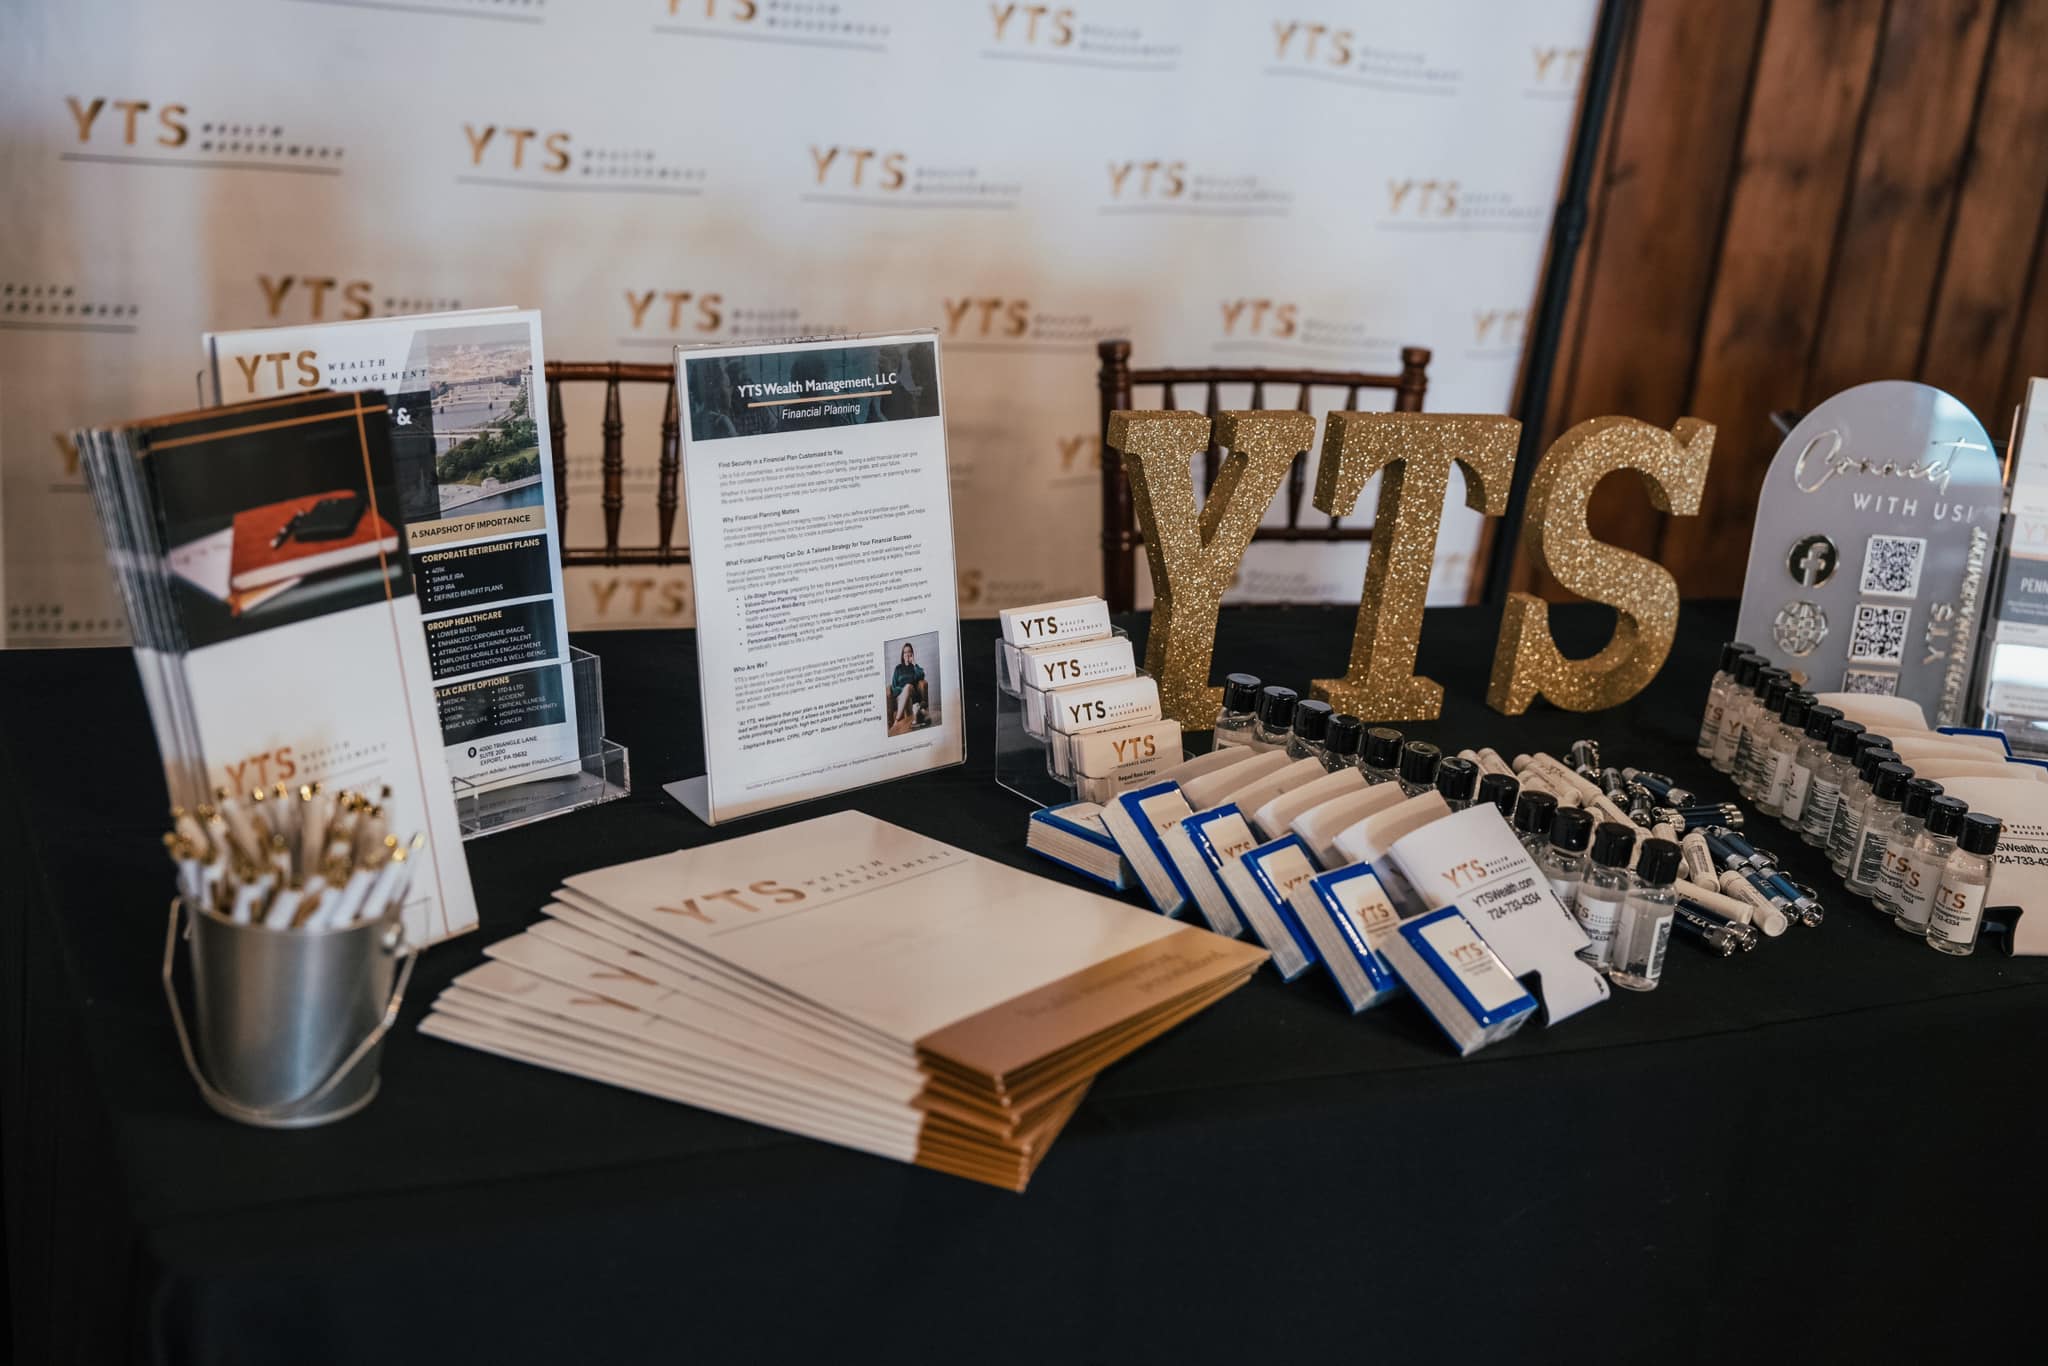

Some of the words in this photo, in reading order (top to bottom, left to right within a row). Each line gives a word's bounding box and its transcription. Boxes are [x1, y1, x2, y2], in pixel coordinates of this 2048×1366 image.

[988, 2, 1075, 47] YTS
[1273, 20, 1354, 66] YTS
[65, 96, 190, 150] YTS
[463, 124, 573, 174] YTS
[808, 144, 908, 192] YTS
[1107, 160, 1188, 199] YTS
[1387, 179, 1460, 217] YTS
[256, 274, 375, 320] YTS
[625, 290, 724, 334] YTS
[943, 297, 1030, 339] YTS
[1220, 299, 1298, 339] YTS
[235, 350, 321, 393] YTS
[328, 358, 386, 371] WEALTH
[330, 369, 428, 386] MANAGEMENT
[737, 384, 762, 398] YTS
[763, 380, 803, 396] Wealth
[805, 375, 875, 393] Management,
[875, 373, 897, 386] LLC
[396, 407, 412, 426] &
[782, 406, 821, 420] Financial
[823, 402, 860, 416] Planning
[763, 455, 785, 463] Financial
[1794, 428, 1988, 495] Connect
[734, 513, 757, 522] Financial
[758, 510, 780, 519] Planning
[782, 508, 800, 516] Matters
[1853, 492, 1918, 517] WITH
[1933, 502, 1974, 524] US!
[419, 525, 463, 537] SNAPSHOT
[464, 523, 476, 531] OF
[476, 515, 531, 529] IMPORTANCE
[422, 550, 467, 563] CORPORATE
[468, 543, 513, 556] RETIREMENT
[514, 539, 540, 549] PLANS
[739, 555, 763, 565] Financial
[763, 552, 786, 561] Planning
[811, 545, 831, 555] Tailored
[831, 543, 851, 552] Strategy
[871, 537, 892, 546] Financial
[893, 534, 912, 543] Success
[1106, 408, 1717, 733] YTS
[434, 591, 460, 601] DEFINED
[460, 587, 484, 597] BENEFIT
[484, 584, 503, 593] PLANS
[591, 578, 685, 617] YTS
[427, 619, 454, 631] GROUP
[454, 611, 502, 626] HEALTHCARE
[437, 629, 458, 638] LOWER
[459, 626, 477, 634] RATES
[1020, 616, 1058, 638] YTS
[1921, 602, 1954, 665] YTS
[438, 636, 470, 647] ENHANCED
[471, 629, 505, 641] CORPORATE
[506, 626, 525, 635] IMAGE
[438, 644, 473, 656] ATTRACTING
[478, 638, 509, 649] RETAINING
[510, 634, 532, 643] TALENT
[440, 654, 470, 665] EMPLOYEE
[470, 650, 495, 660] MORALE
[500, 641, 542, 654] ENGAGEMENT
[440, 663, 471, 674] EMPLOYEE
[471, 658, 503, 669] RETENTION
[1044, 659, 1081, 682] YTS
[442, 688, 452, 697] LA
[453, 683, 476, 694] CARTE
[477, 676, 510, 689] OPTIONS
[1069, 700, 1106, 723] YTS
[480, 751, 495, 759] SUITE
[493, 739, 521, 749] TRIANGLE
[521, 736, 538, 744] LANE
[1112, 735, 1156, 763] YTS
[225, 745, 296, 796] YTS
[803, 859, 883, 885] WEALTH
[821, 850, 951, 893] MANAGEMENT
[1441, 858, 1488, 889] YTS
[653, 880, 807, 924] YTS
[1472, 878, 1536, 908] YTSWealth.com
[1487, 892, 1542, 921] 724-733-4334
[1357, 903, 1389, 923] YTS
[1449, 943, 1484, 962] YTS
